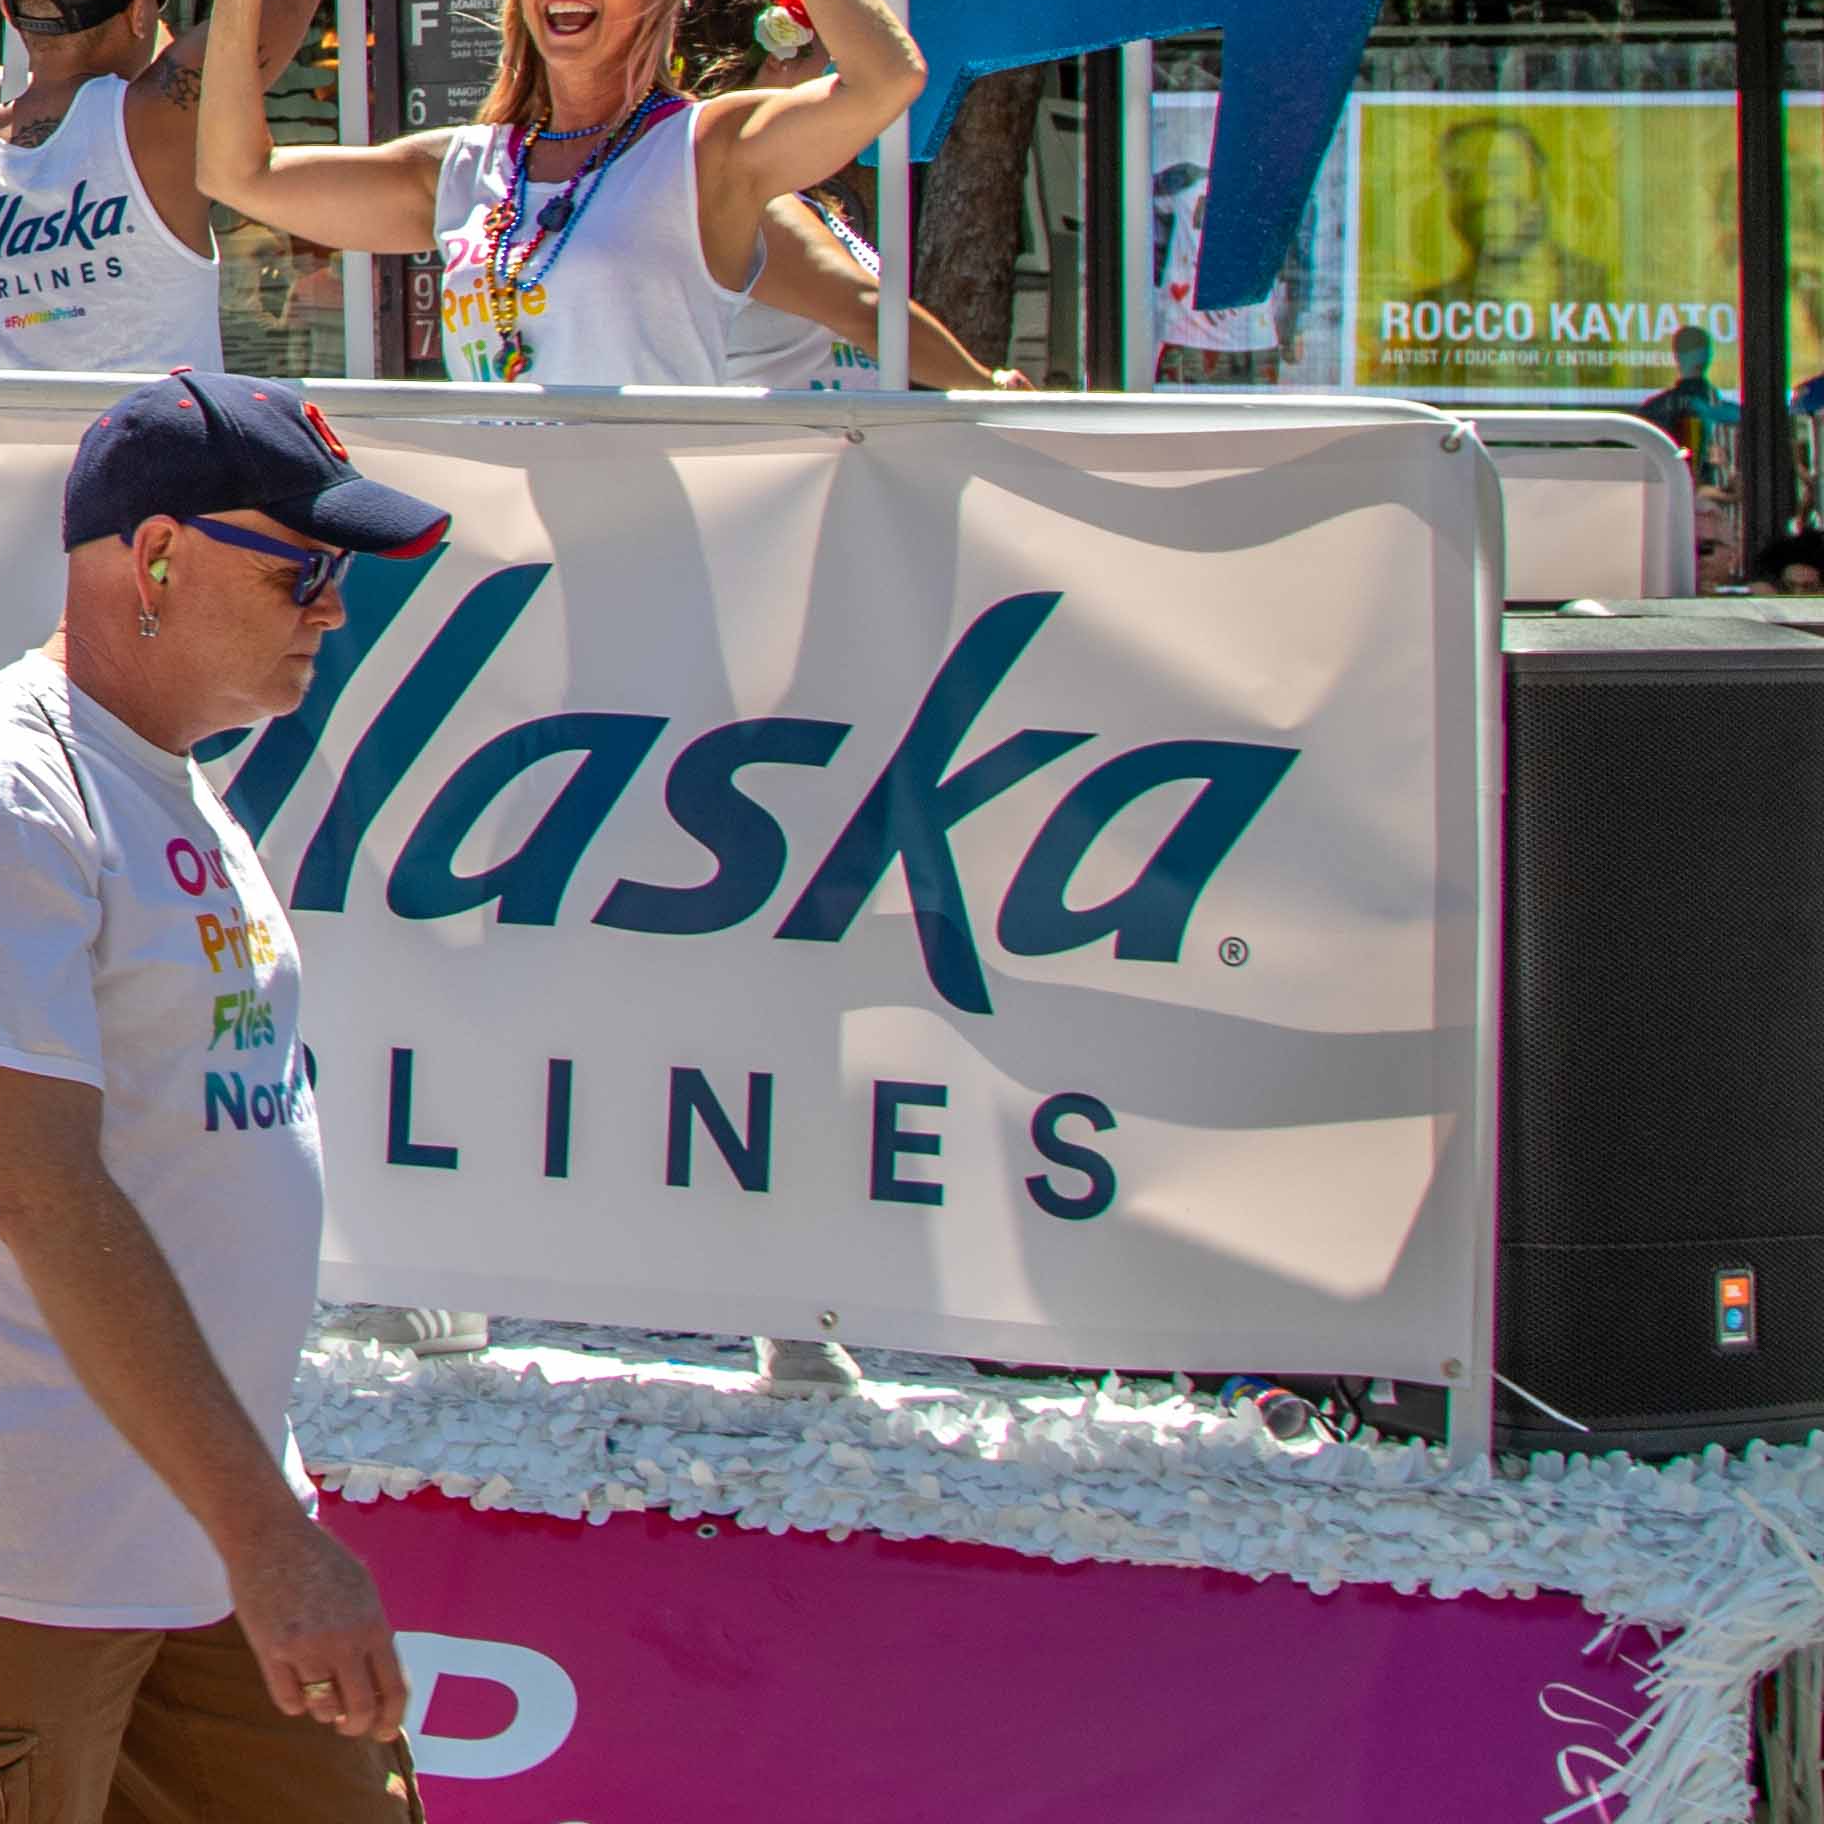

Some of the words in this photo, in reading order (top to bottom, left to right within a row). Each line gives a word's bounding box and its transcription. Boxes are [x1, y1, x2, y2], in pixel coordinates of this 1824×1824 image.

[411, 1, 440, 46] F
[407, 87, 427, 125] 6
[413, 273, 435, 311] 9
[441, 278, 548, 333] Prie
[4, 305, 86, 329] #FlyWithPride
[1380, 301, 1535, 343] ROCCO
[415, 319, 435, 357] 7
[1381, 349, 1439, 366] ARTIST
[1454, 349, 1540, 366] EDUCATOR
[1555, 350, 1676, 368] ENTREPRENEU
[207, 987, 275, 1052] Flies
[385, 1047, 1119, 1222] LINES
